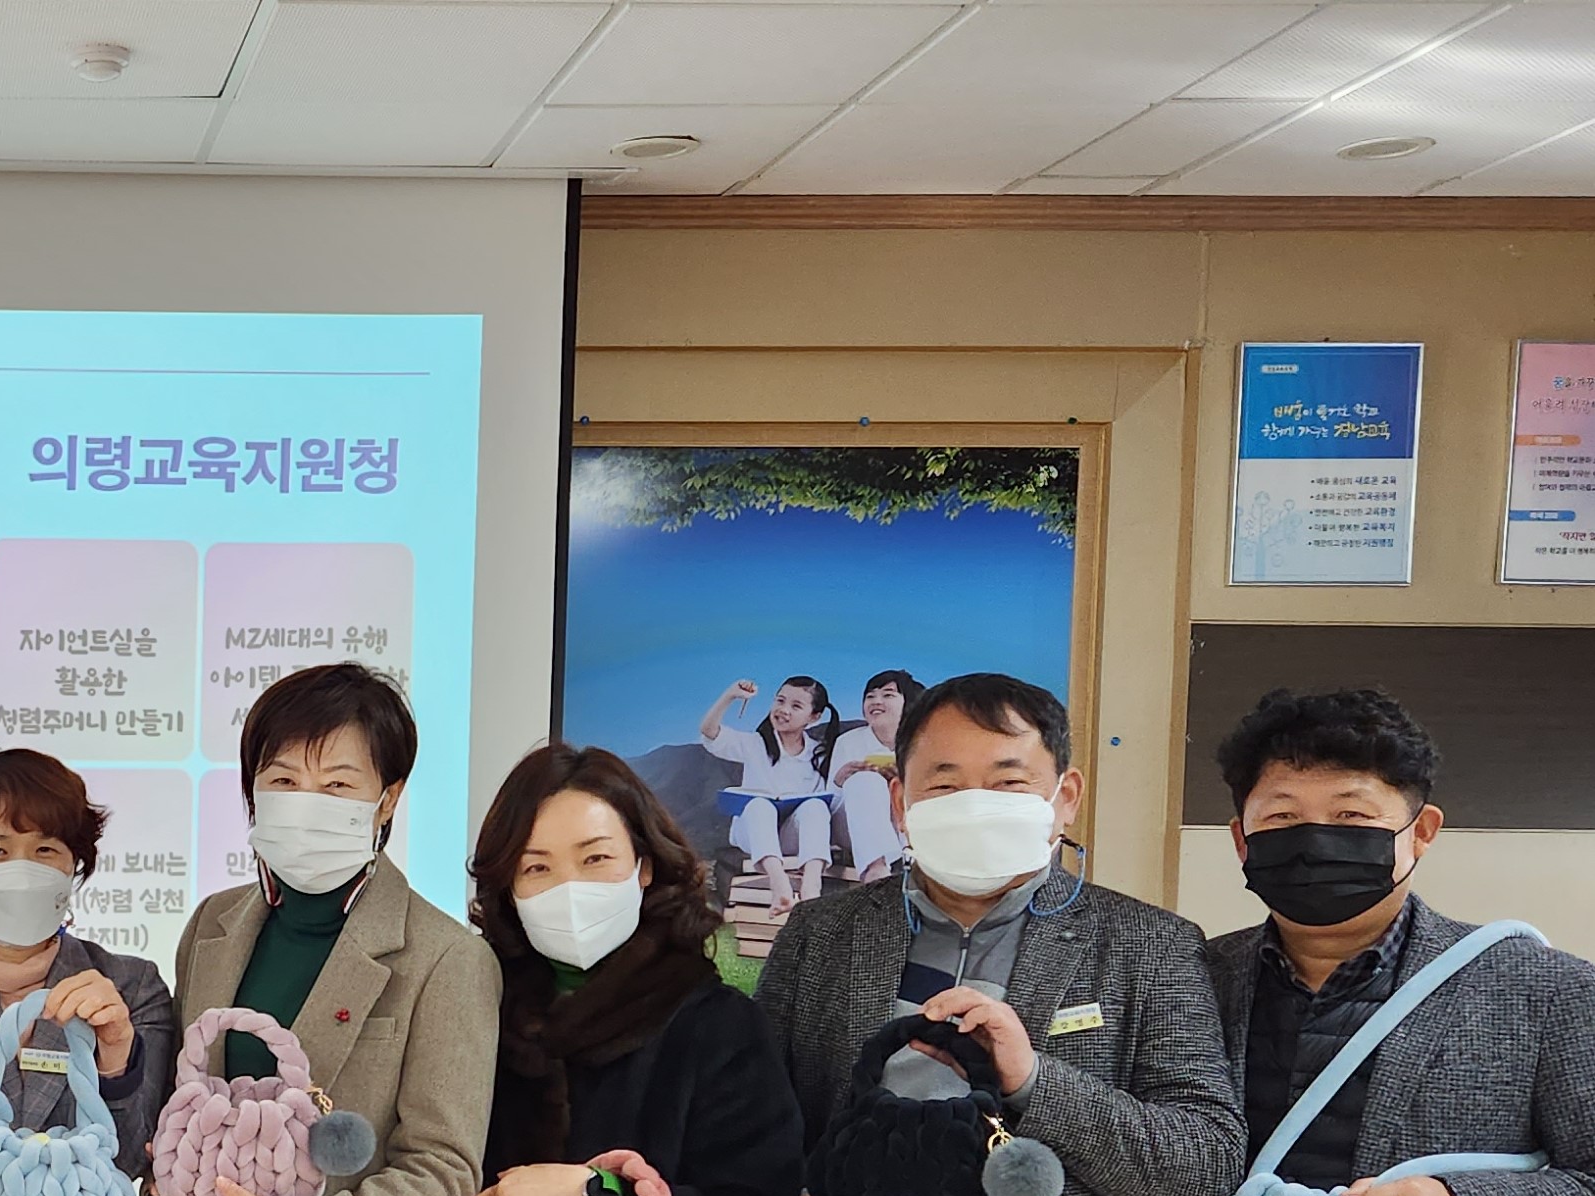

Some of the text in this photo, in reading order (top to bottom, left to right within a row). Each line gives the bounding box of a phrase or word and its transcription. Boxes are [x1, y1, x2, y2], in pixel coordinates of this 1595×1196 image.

[28, 434, 399, 495] 의령교육지원청
[19, 628, 157, 658] 자이언트실을
[225, 626, 388, 654] MZ세대의 유행
[55, 666, 128, 697] 활용한
[115, 709, 184, 737] 만들기
[122, 851, 187, 876] 보내는
[139, 888, 184, 914] 실천
